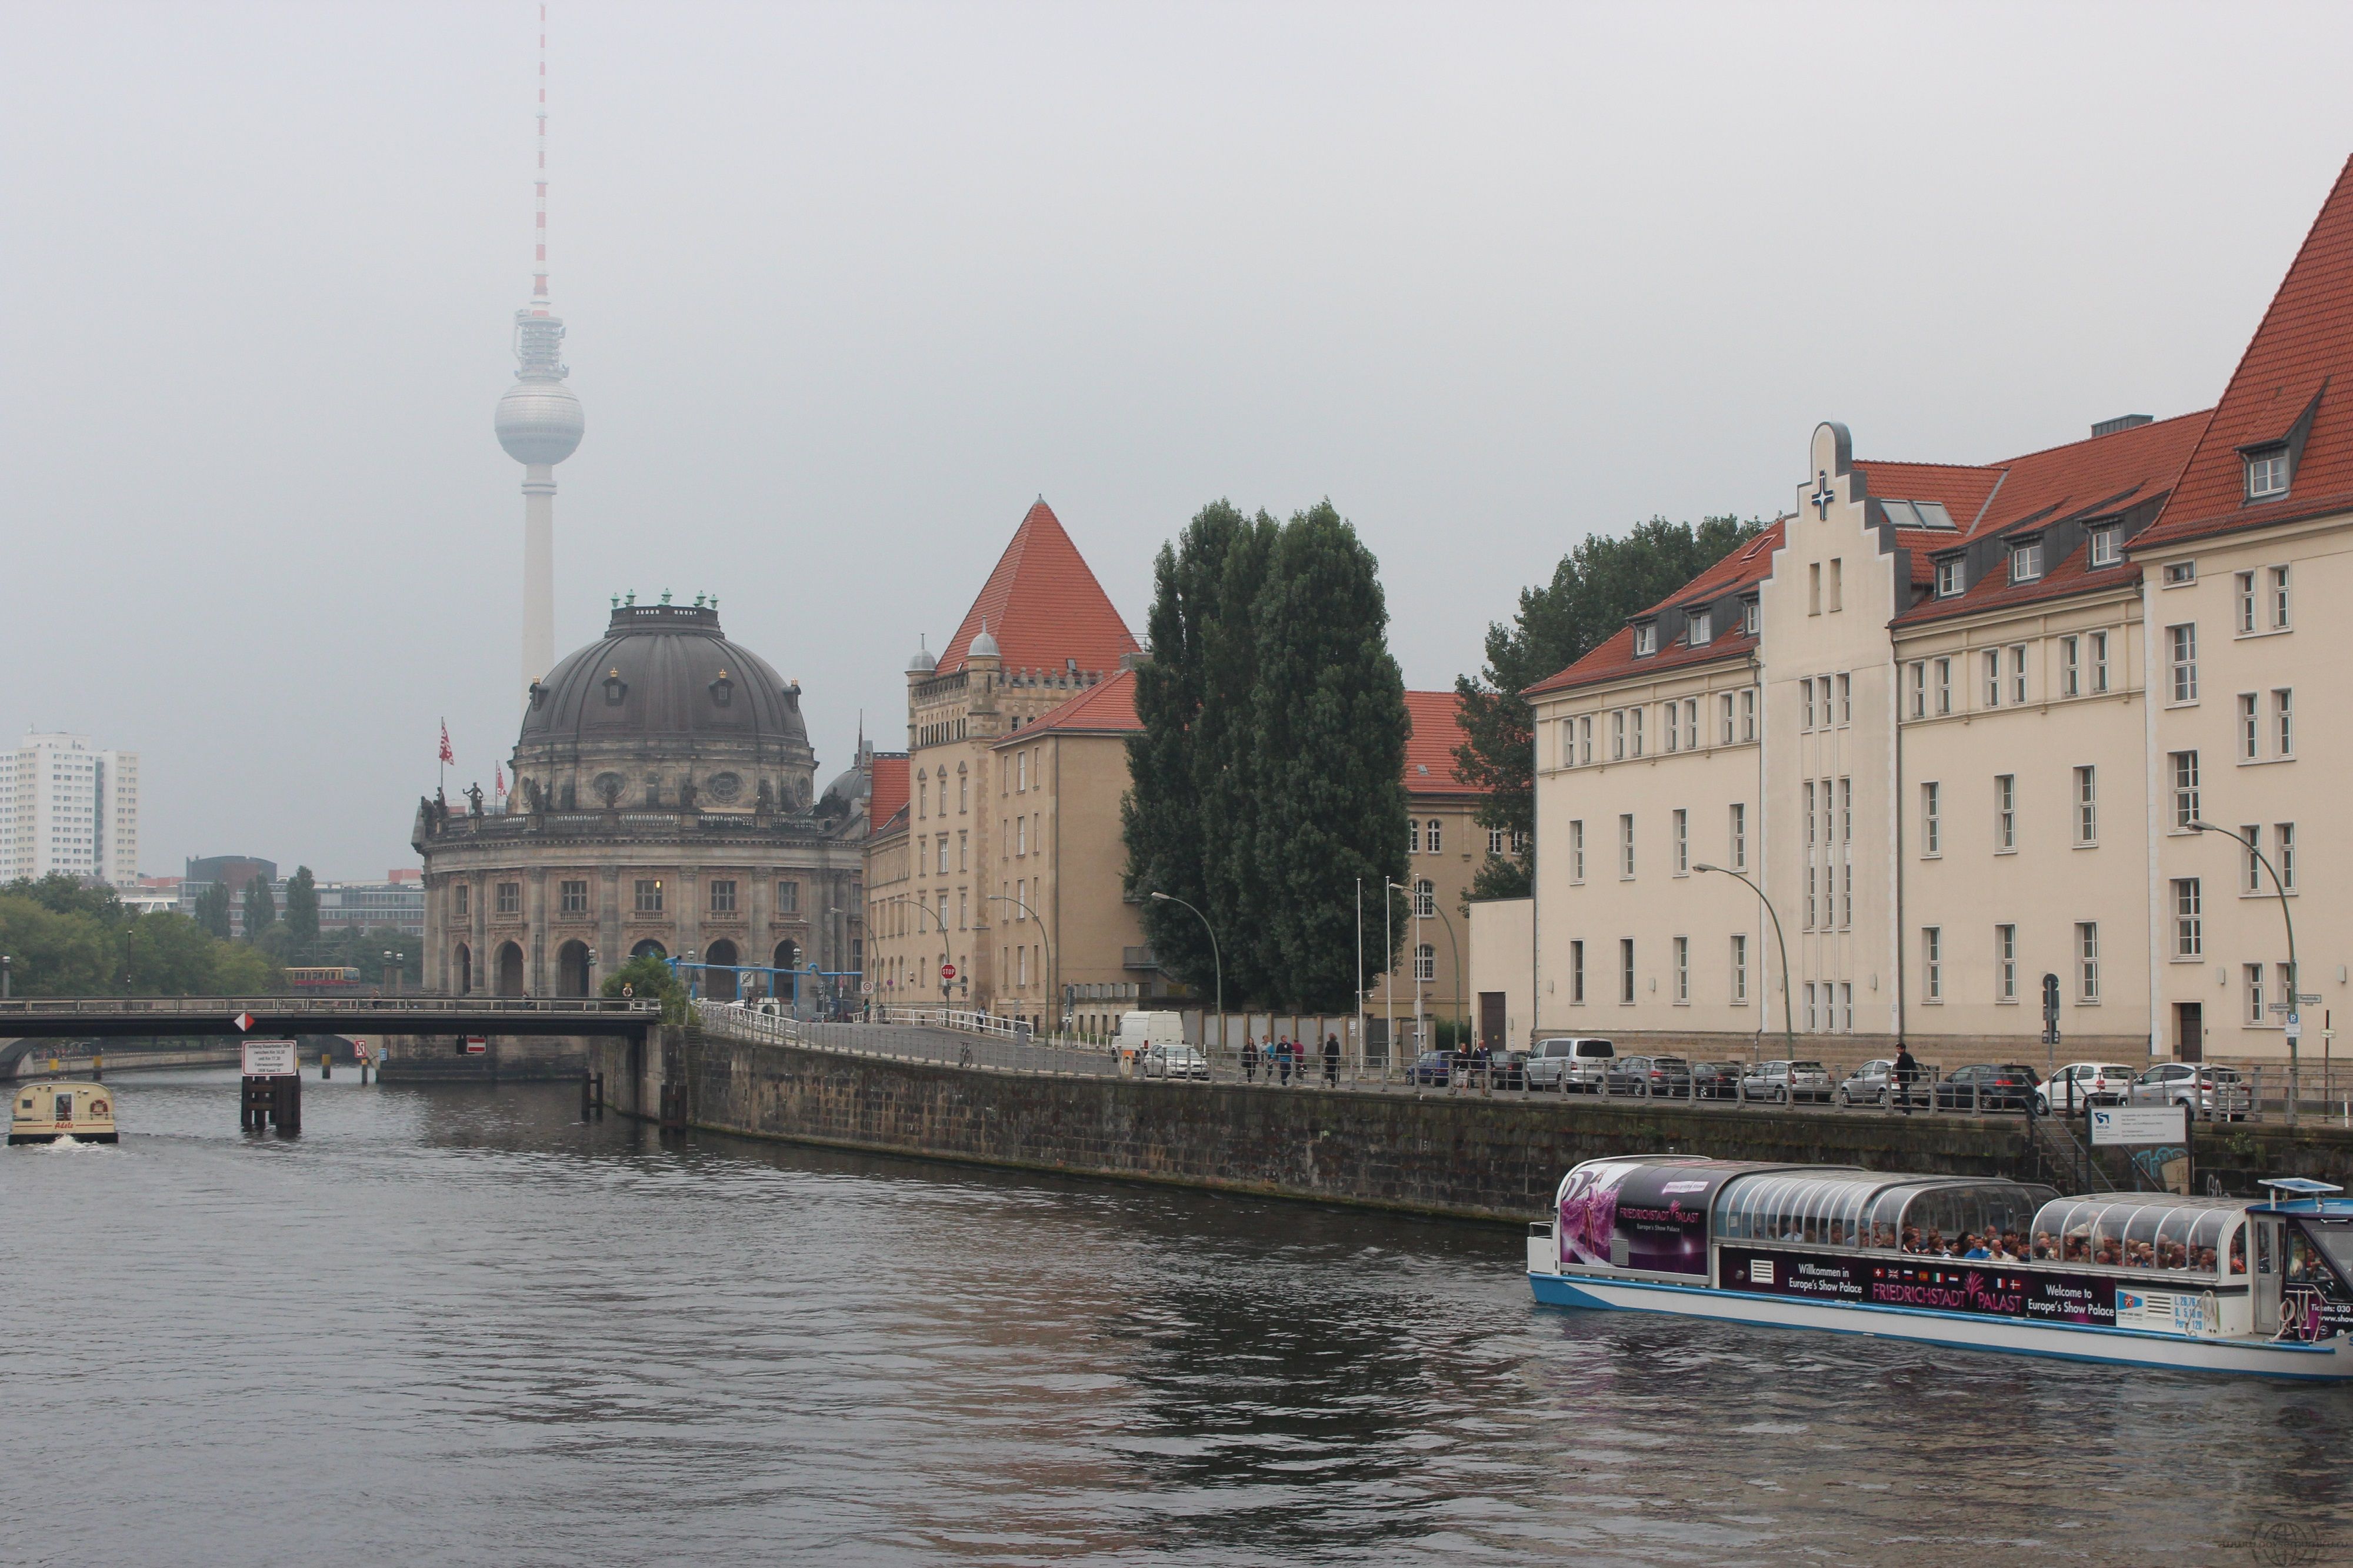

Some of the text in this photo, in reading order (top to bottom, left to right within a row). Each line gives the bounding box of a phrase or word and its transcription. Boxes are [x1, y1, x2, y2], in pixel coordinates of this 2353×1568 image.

[1619, 1207, 1699, 1223] FRIEDRICHSTADT PALAST
[1798, 1263, 1849, 1277] Willkommen in
[1789, 1277, 1862, 1293] Europe's Show Palace
[2045, 1284, 2092, 1299] Welcome to
[1872, 1283, 2022, 1312] FRIEDRICHSTADT PALAST
[2028, 1299, 2115, 1316] Europe's Show Palace
[2192, 1320, 2202, 1330] 120
